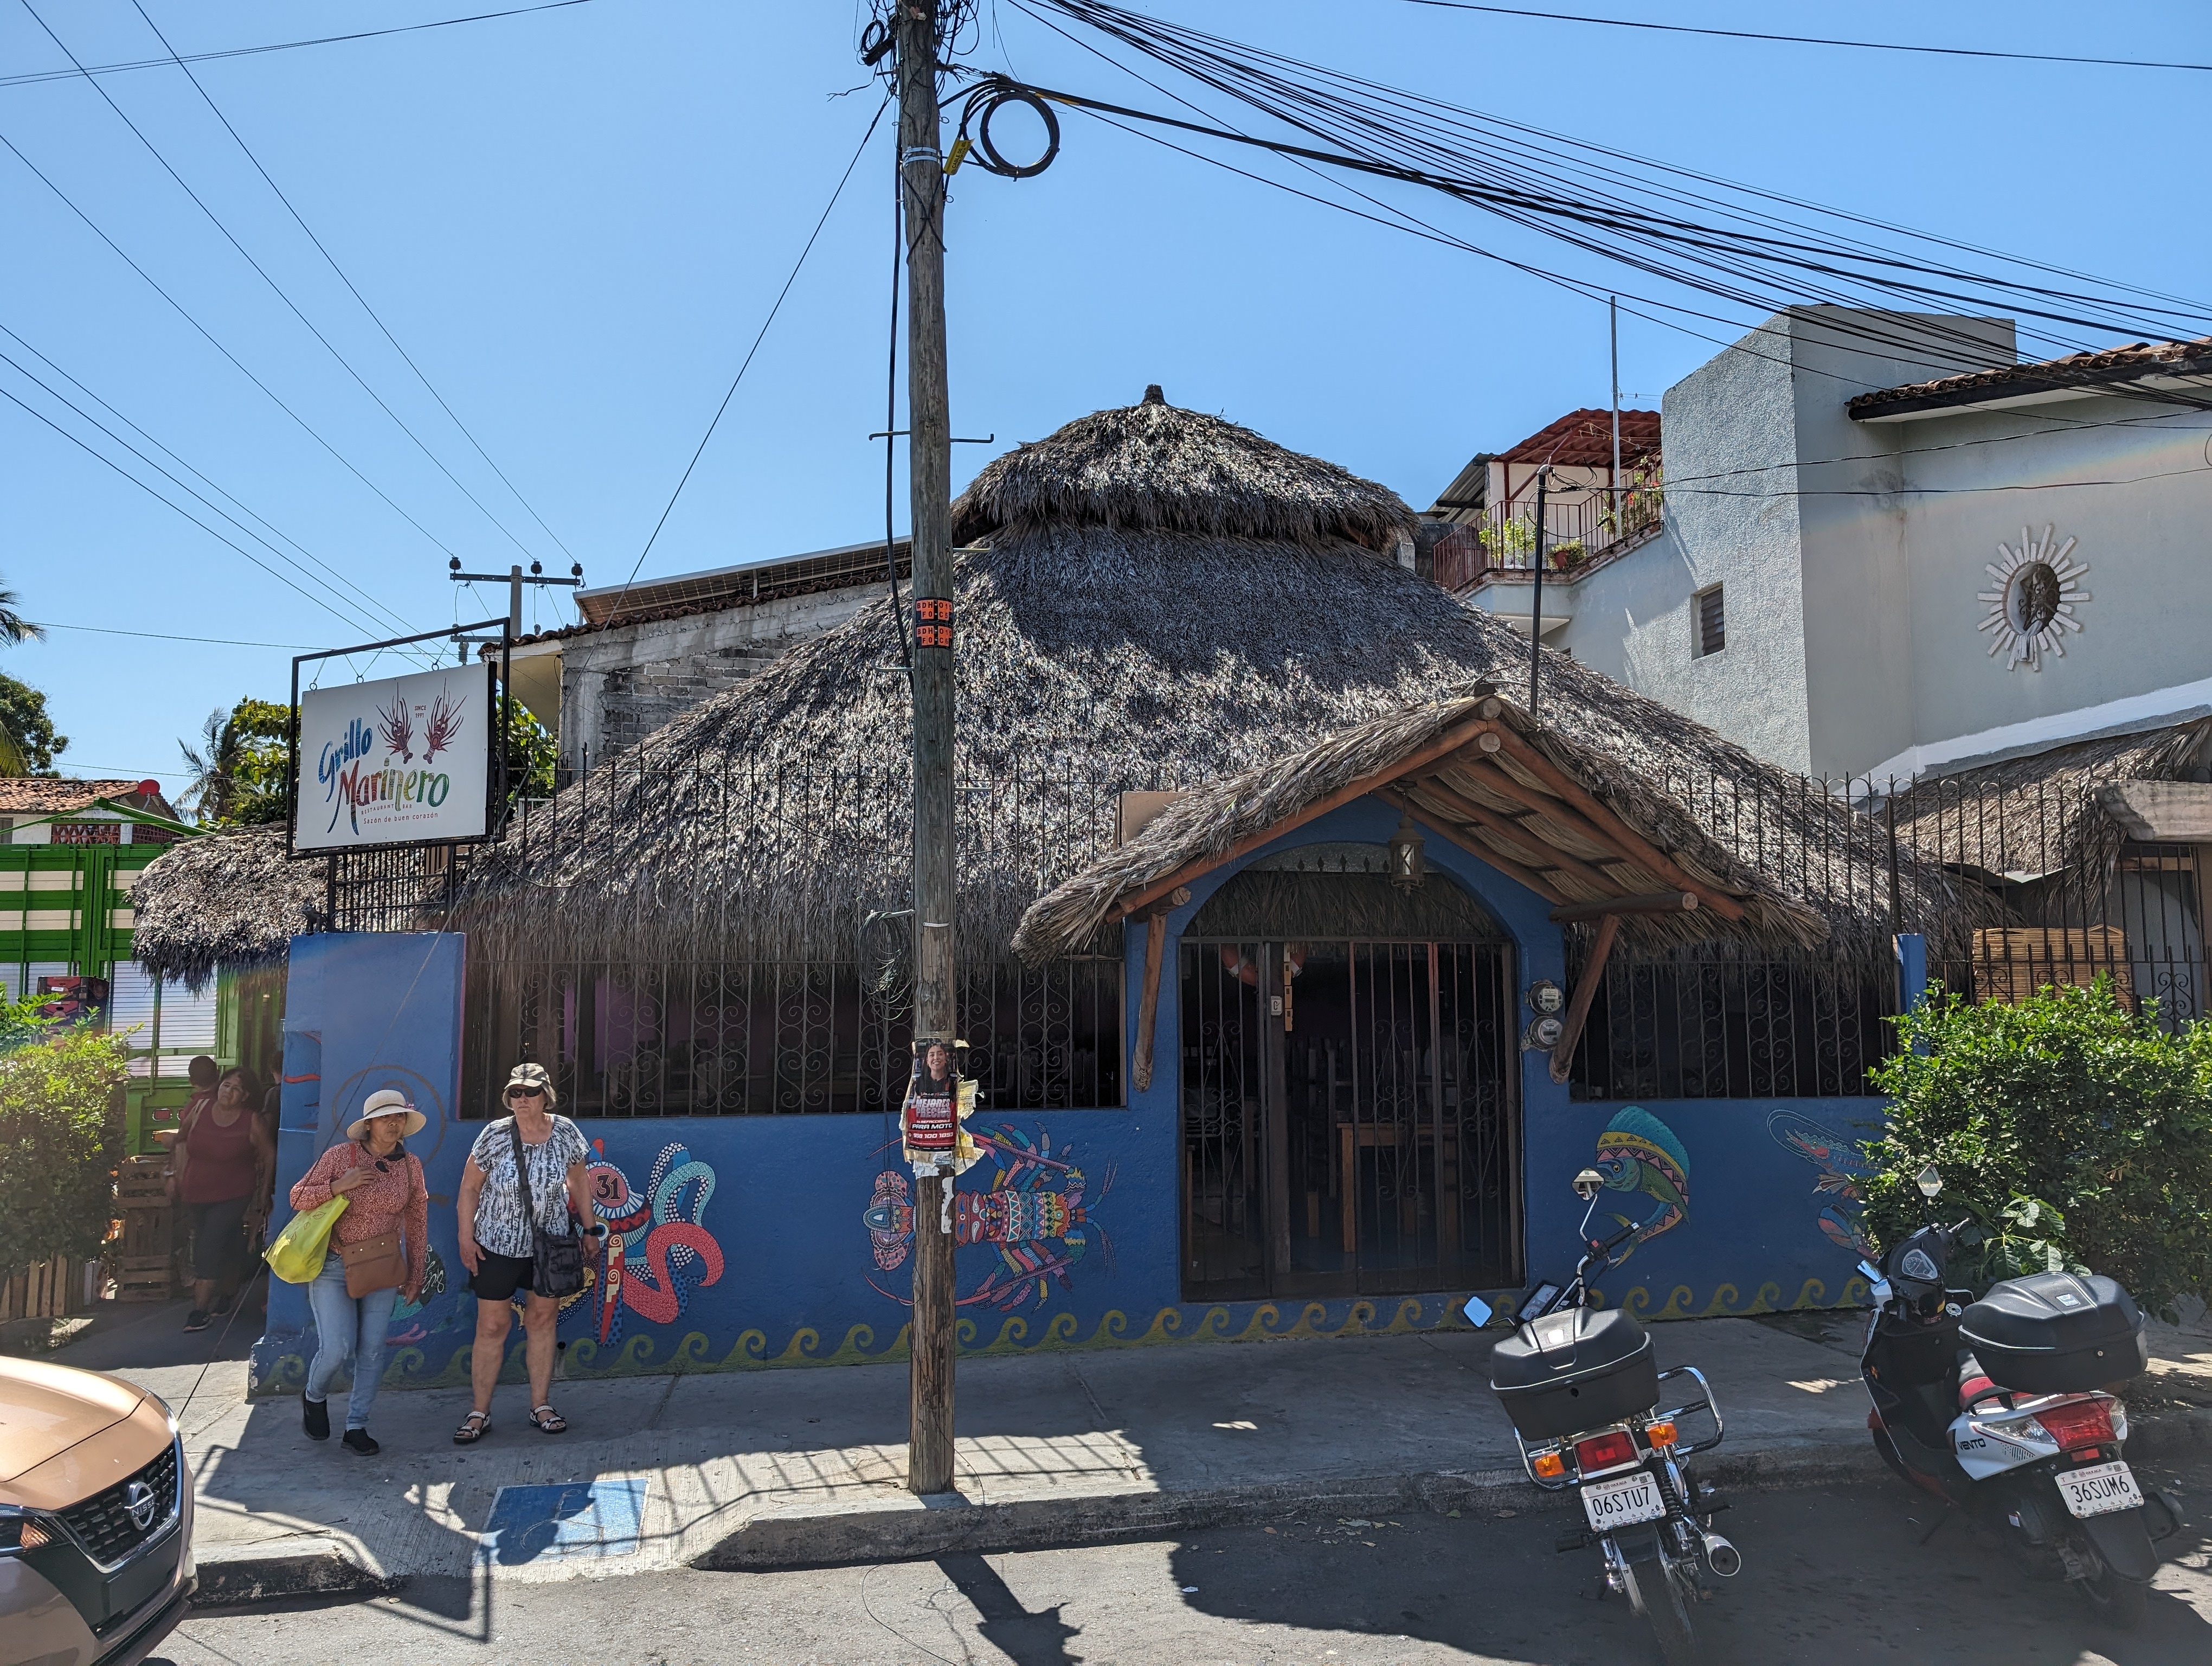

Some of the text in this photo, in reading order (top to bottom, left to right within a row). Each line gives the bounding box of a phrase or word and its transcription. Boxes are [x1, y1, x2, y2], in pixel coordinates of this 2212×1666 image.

[318, 717, 372, 803] Grillo
[326, 757, 449, 836] Marinero
[361, 804, 394, 815] RESTAURANT
[916, 1098, 950, 1107] MEJORES
[916, 1107, 951, 1118] PRECIOS
[595, 1173, 622, 1201] 31
[1957, 1438, 1986, 1450] VENTO
[2070, 1475, 2130, 1503] 36SUM6
[132, 1498, 155, 1516] NISSA
[1592, 1486, 1649, 1516] 06STU7
